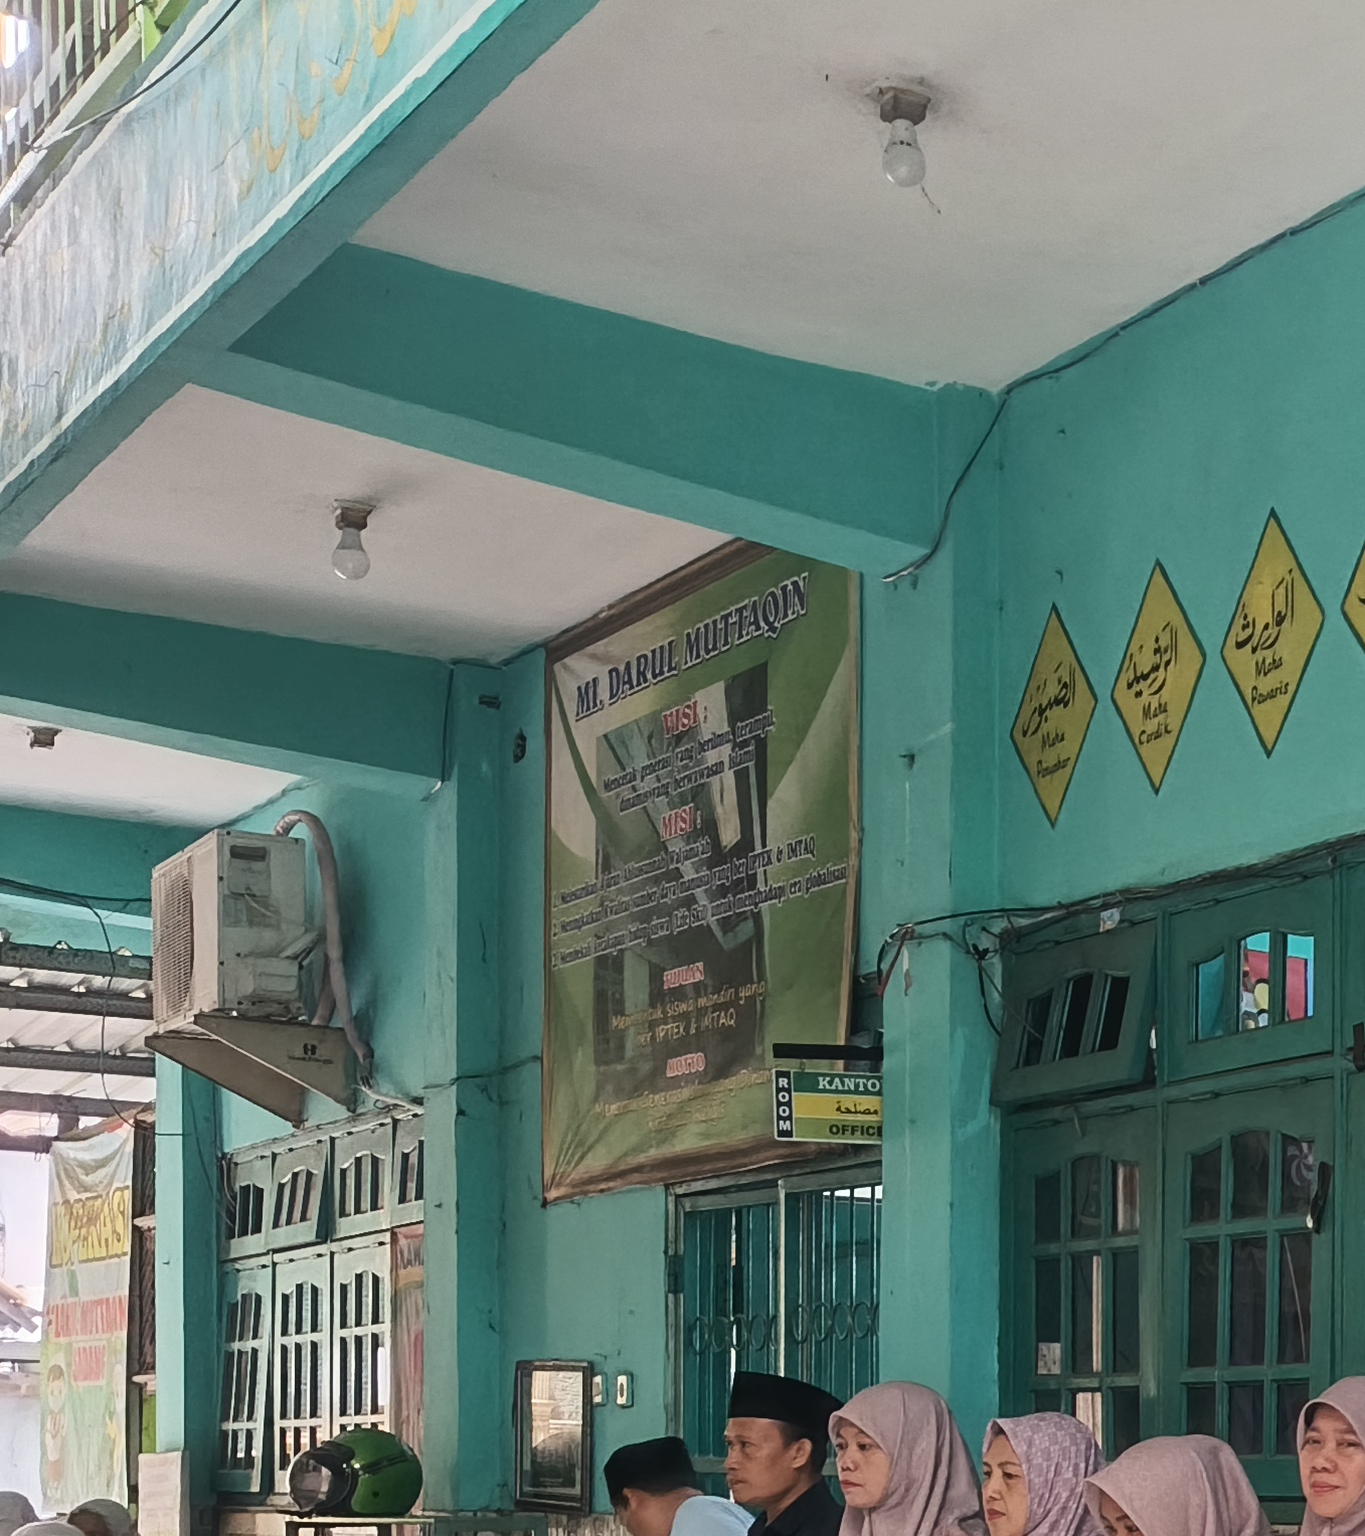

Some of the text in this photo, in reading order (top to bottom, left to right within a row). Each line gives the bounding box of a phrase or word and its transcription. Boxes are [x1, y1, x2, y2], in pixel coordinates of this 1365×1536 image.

[608, 637, 678, 706] DARUL
[682, 572, 809, 670] MUTTAQIN
[1255, 650, 1283, 680] Maha
[662, 699, 699, 738] VISI
[1141, 695, 1169, 725] Maha
[660, 804, 694, 842] MISI
[786, 833, 816, 860] IMTAQ
[663, 962, 705, 989] TUJUAN
[738, 981, 766, 1005] yang
[656, 1020, 686, 1043] IPTEK
[700, 1008, 737, 1032] IMTAQ
[817, 1076, 882, 1092] KANTO
[777, 1077, 792, 1132] ROOM
